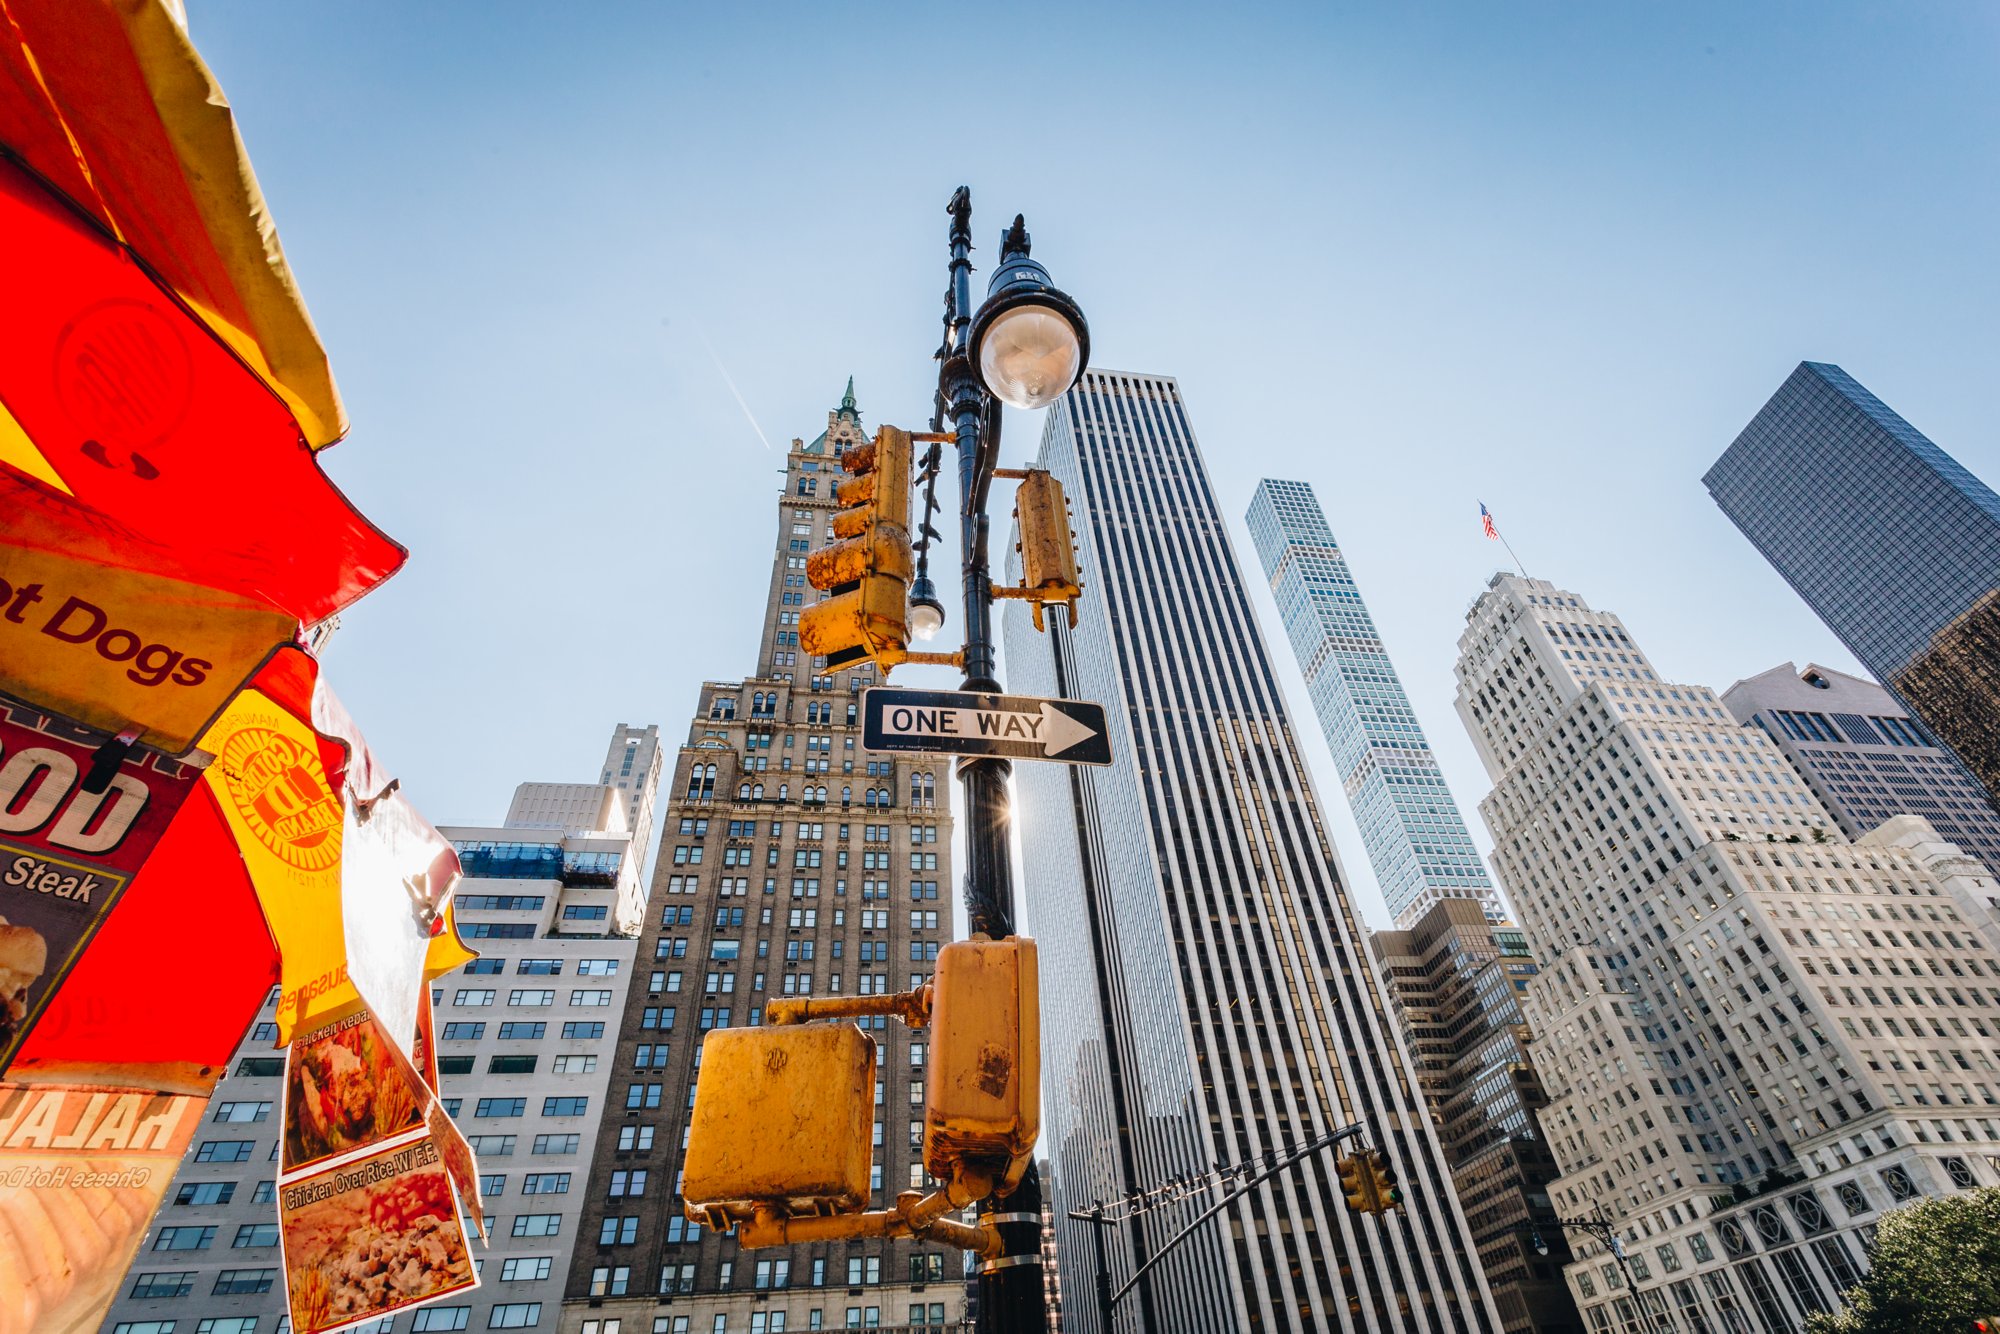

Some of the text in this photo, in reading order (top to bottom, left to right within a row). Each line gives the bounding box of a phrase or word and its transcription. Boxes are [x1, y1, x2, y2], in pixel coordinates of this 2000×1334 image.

[0, 577, 213, 687] t Dogs
[892, 708, 1043, 739] ONE WAY
[0, 737, 151, 853] OD
[4, 856, 101, 904] Steak
[285, 1181, 333, 1210] Chicken
[333, 1171, 366, 1195] Over
[364, 1161, 395, 1186] Rice
[394, 1150, 416, 1174] W/
[415, 1143, 439, 1168] F.F.
